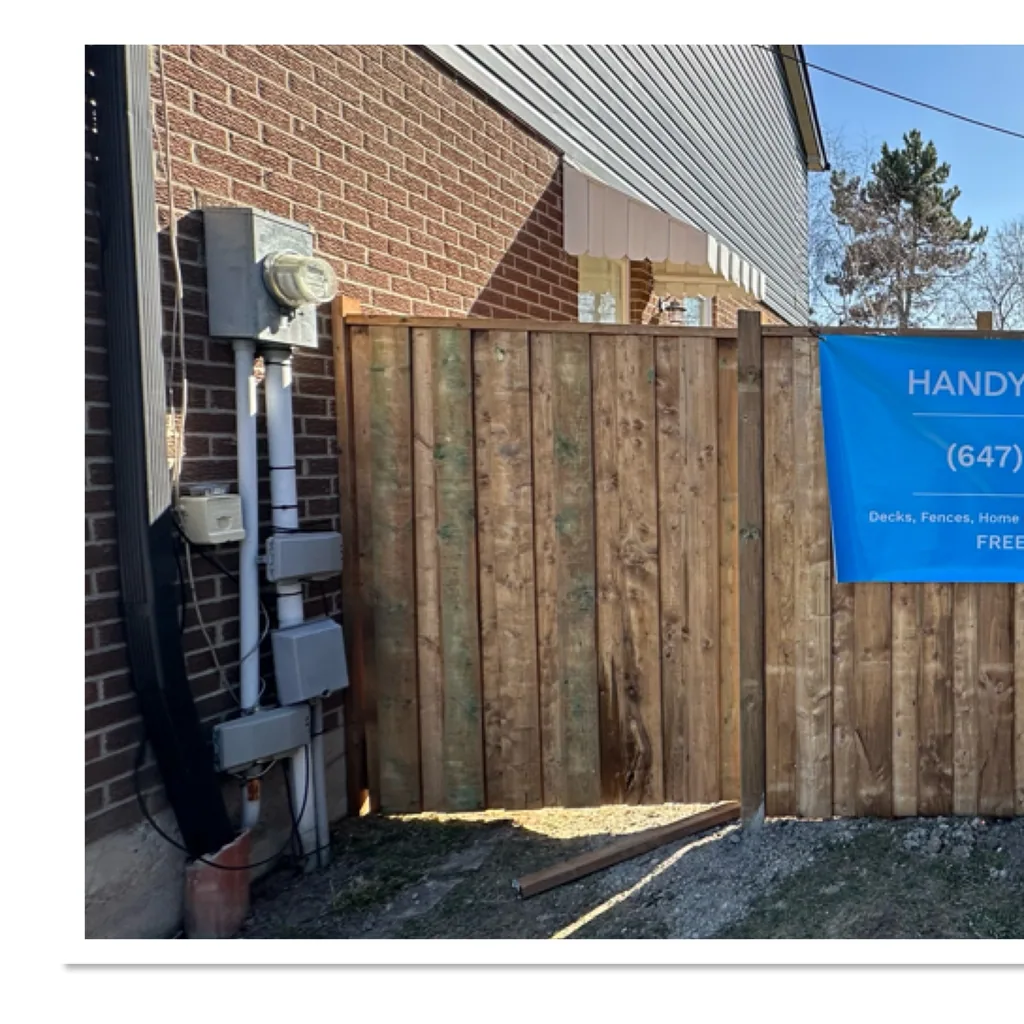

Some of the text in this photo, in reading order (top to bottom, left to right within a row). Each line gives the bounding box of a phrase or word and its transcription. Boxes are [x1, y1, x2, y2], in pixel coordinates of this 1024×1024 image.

[947, 443, 1024, 474] (647)
[869, 511, 916, 524] Decks,
[921, 512, 974, 525] Fences,
[979, 513, 1020, 524] Home
